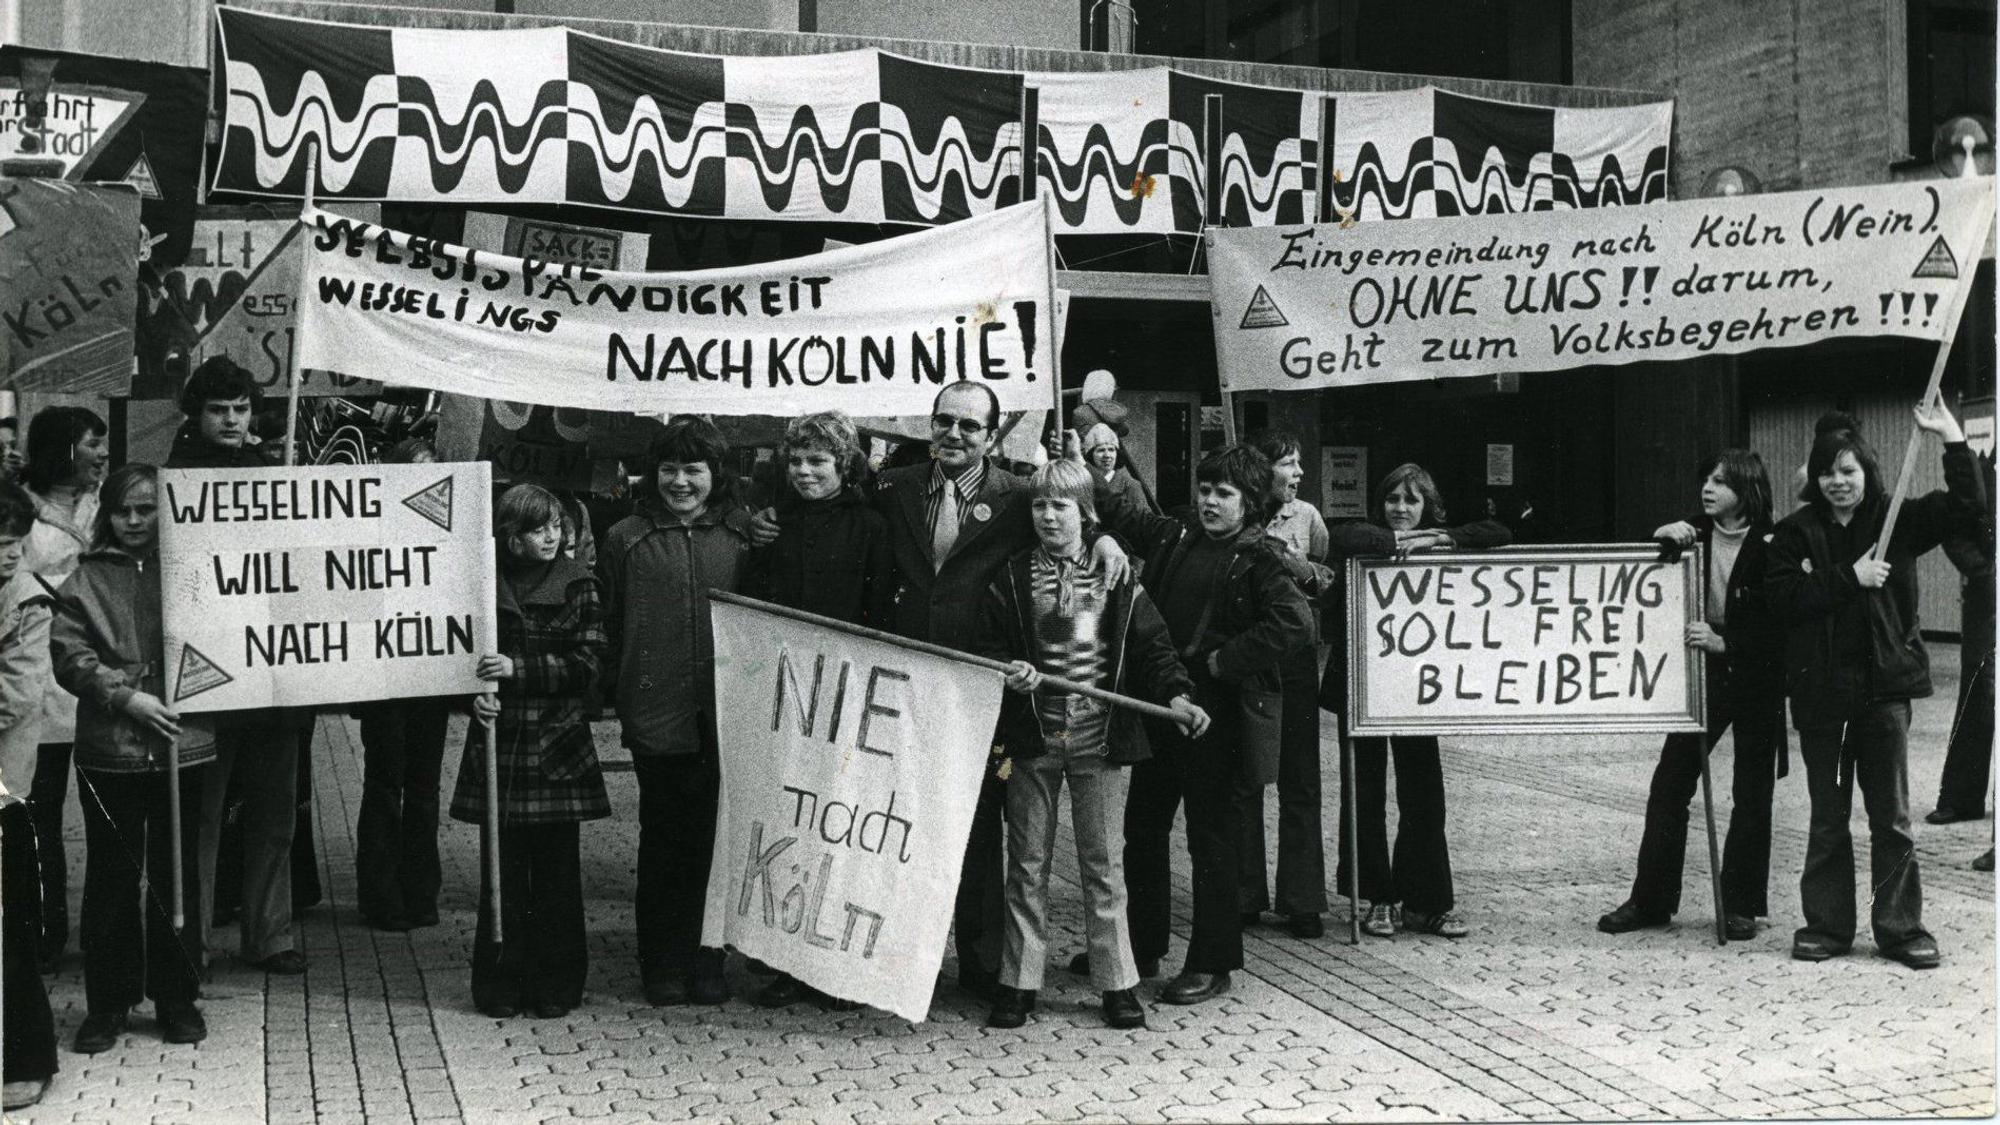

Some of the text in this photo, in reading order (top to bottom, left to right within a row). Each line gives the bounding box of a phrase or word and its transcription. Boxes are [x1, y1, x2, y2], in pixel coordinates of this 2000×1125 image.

[14, 117, 98, 155] Stadt
[1270, 227, 1550, 274] Eingemeindung
[1572, 224, 1656, 258] nach
[1690, 213, 1786, 249] Köln
[1350, 275, 1483, 328] OHNE
[1672, 264, 1834, 297] darum,
[607, 332, 752, 388] NACH
[768, 334, 895, 388] KÖLN
[1280, 332, 1386, 379] Geht
[1422, 335, 1519, 363] zum
[1551, 303, 1860, 355] Volksbegehren
[166, 478, 382, 523] WESSELING
[214, 546, 437, 596] WILL NICHT
[1369, 562, 1665, 610] WESSELING
[246, 611, 474, 667] NACH KÖLN
[1377, 606, 1645, 657] SOLL FREI
[771, 647, 911, 758] NIE
[1418, 648, 1668, 705] BLEIBEN
[783, 785, 913, 863] nach
